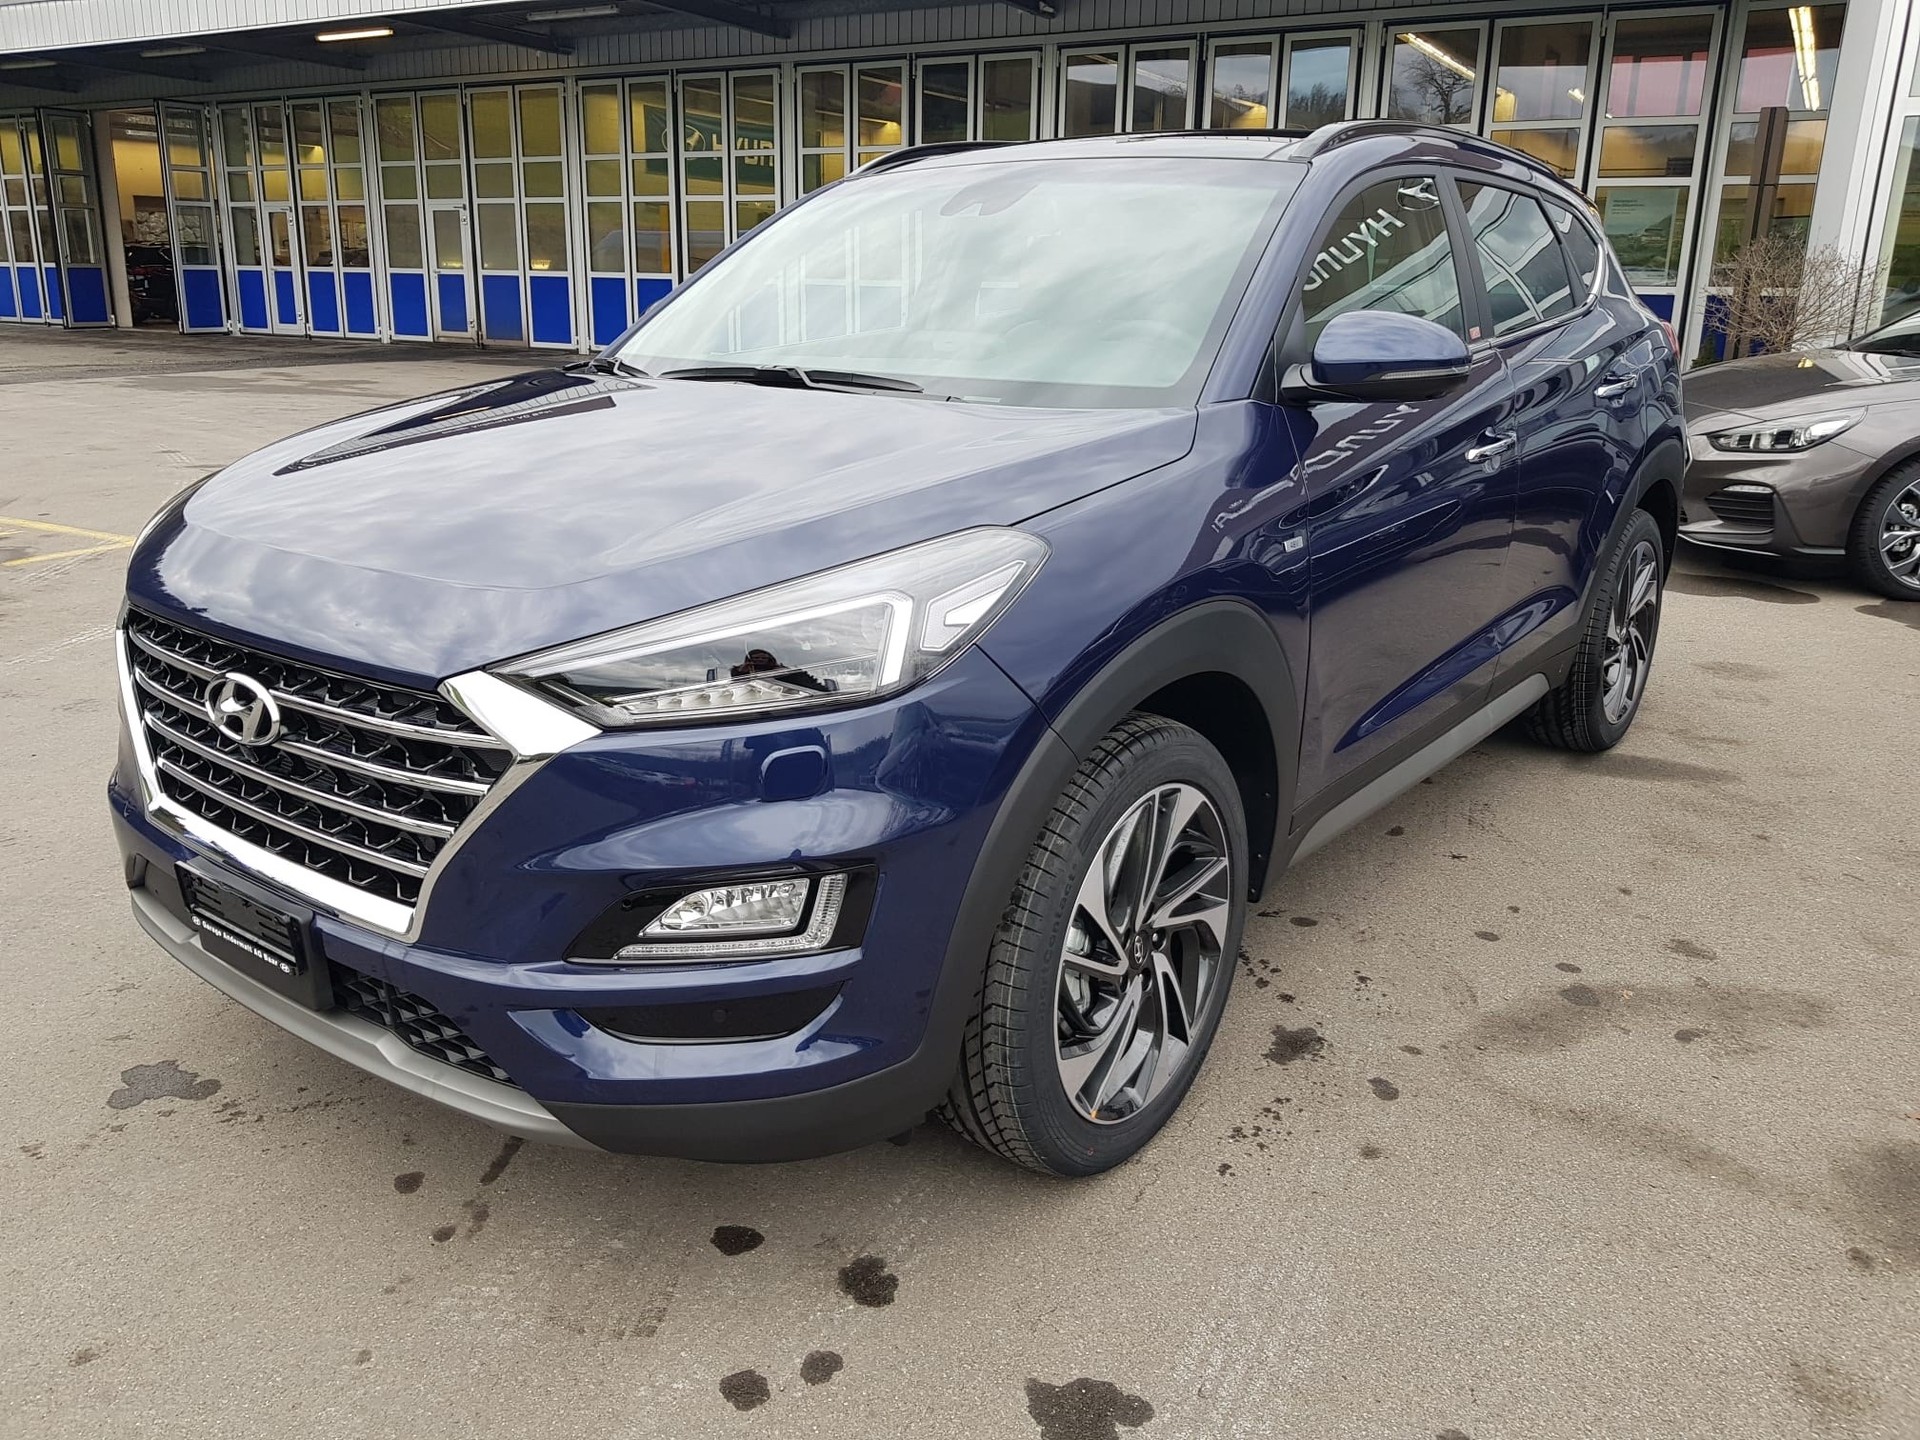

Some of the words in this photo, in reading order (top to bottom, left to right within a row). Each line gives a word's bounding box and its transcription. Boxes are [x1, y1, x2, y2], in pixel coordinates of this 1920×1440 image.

[202, 920, 221, 936] Garage
[223, 932, 253, 953] Andermatt
[253, 948, 263, 958] AG
